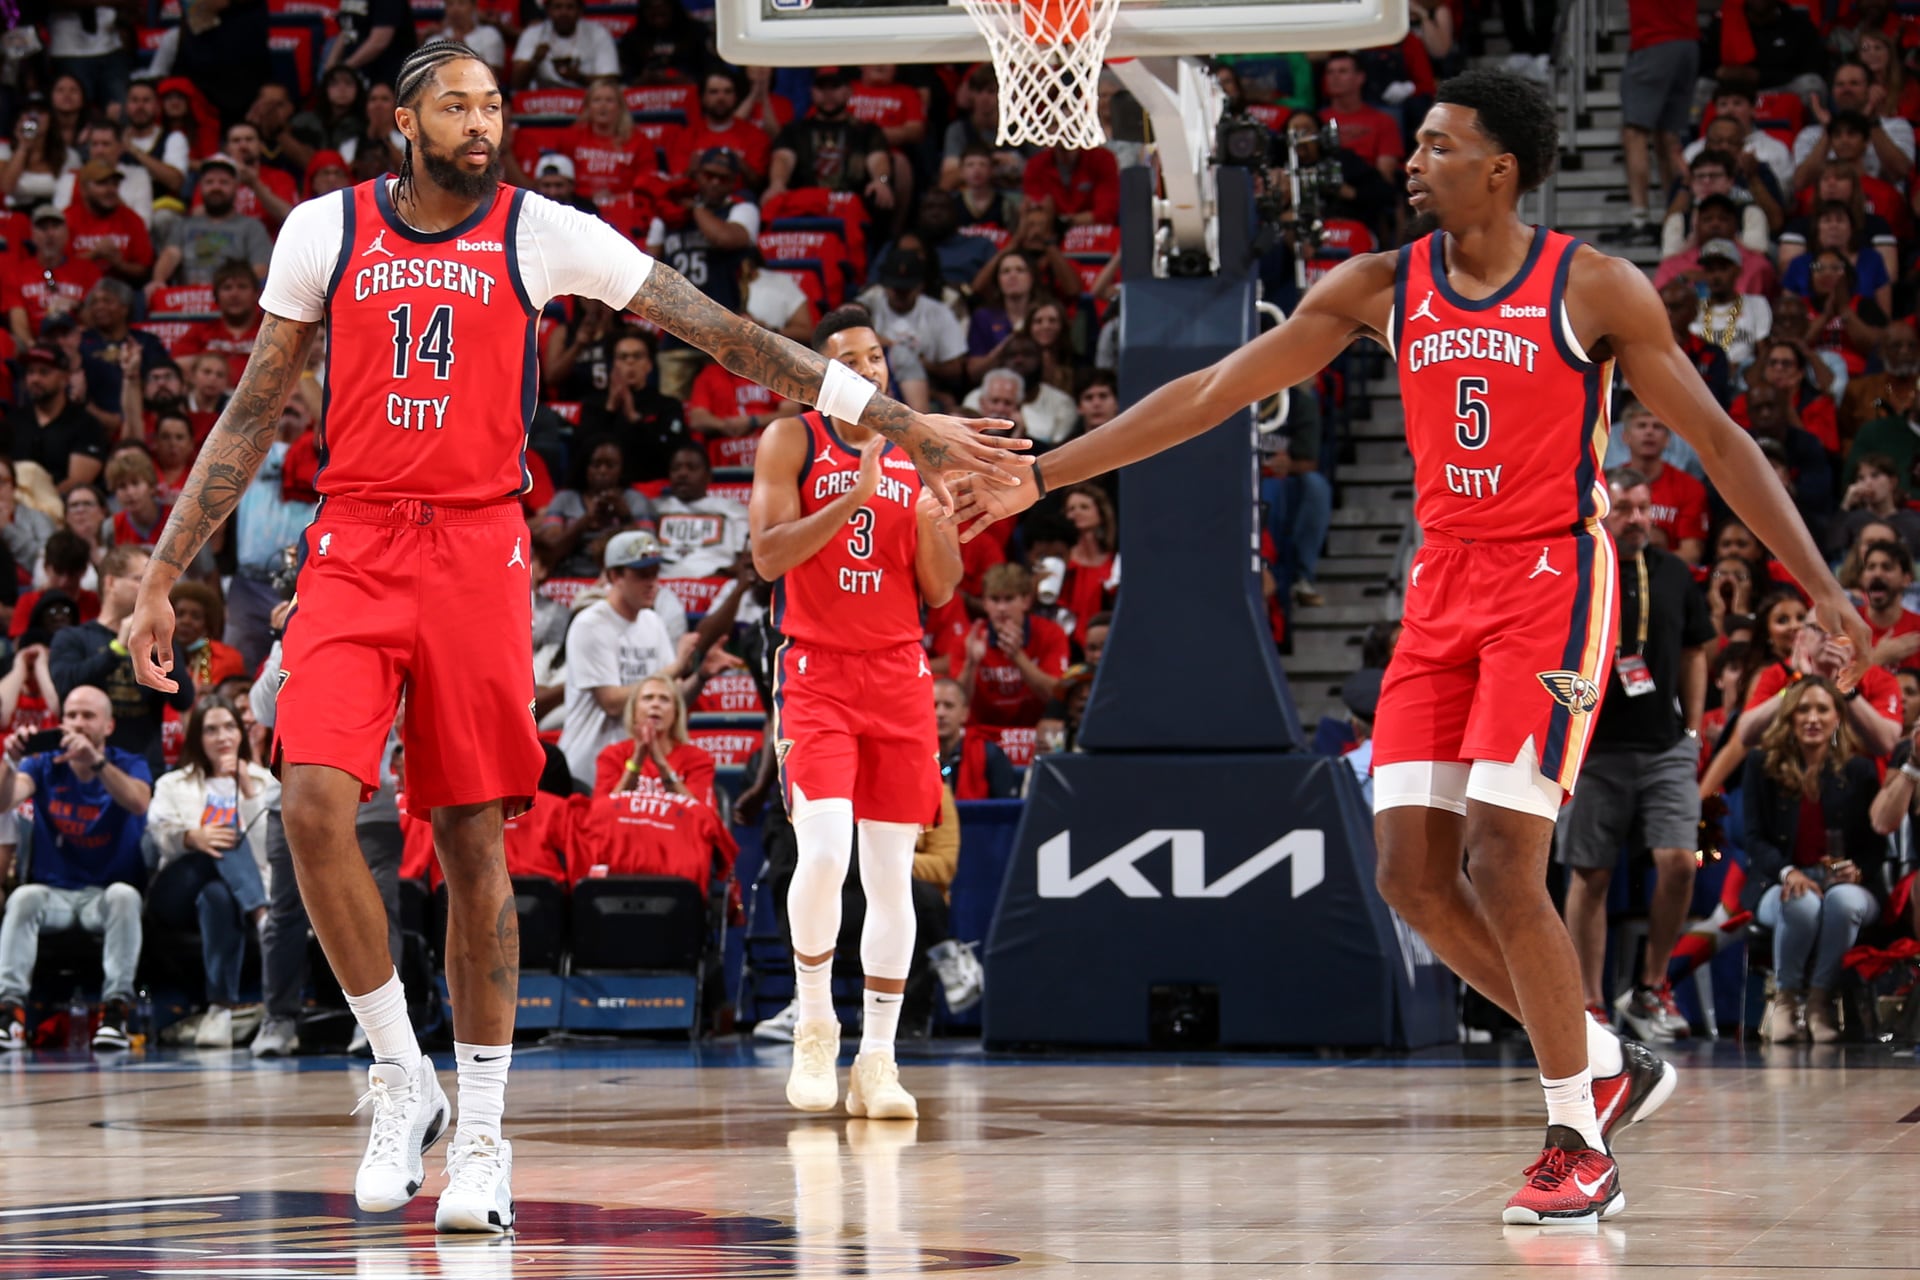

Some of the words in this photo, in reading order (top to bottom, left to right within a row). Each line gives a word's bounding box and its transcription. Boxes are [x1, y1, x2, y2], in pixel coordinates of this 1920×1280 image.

[456, 239, 504, 253] ibotta
[354, 257, 496, 306] CRESCENT
[673, 252, 709, 287] 25
[1500, 304, 1547, 319] ibotta
[387, 303, 455, 381] 14
[1408, 327, 1540, 374] CRESCENT
[386, 392, 451, 431] CITY
[1454, 376, 1491, 451] 5
[883, 457, 917, 471] ibotta
[1444, 463, 1503, 499] CITY
[814, 470, 913, 508] CRESENT
[847, 505, 876, 560] 3
[838, 566, 883, 595] CITY
[721, 692, 757, 710] CITY
[630, 796, 672, 817] CITY
[1037, 829, 1326, 898] KIA
[597, 996, 686, 1009] BETRIVERS
